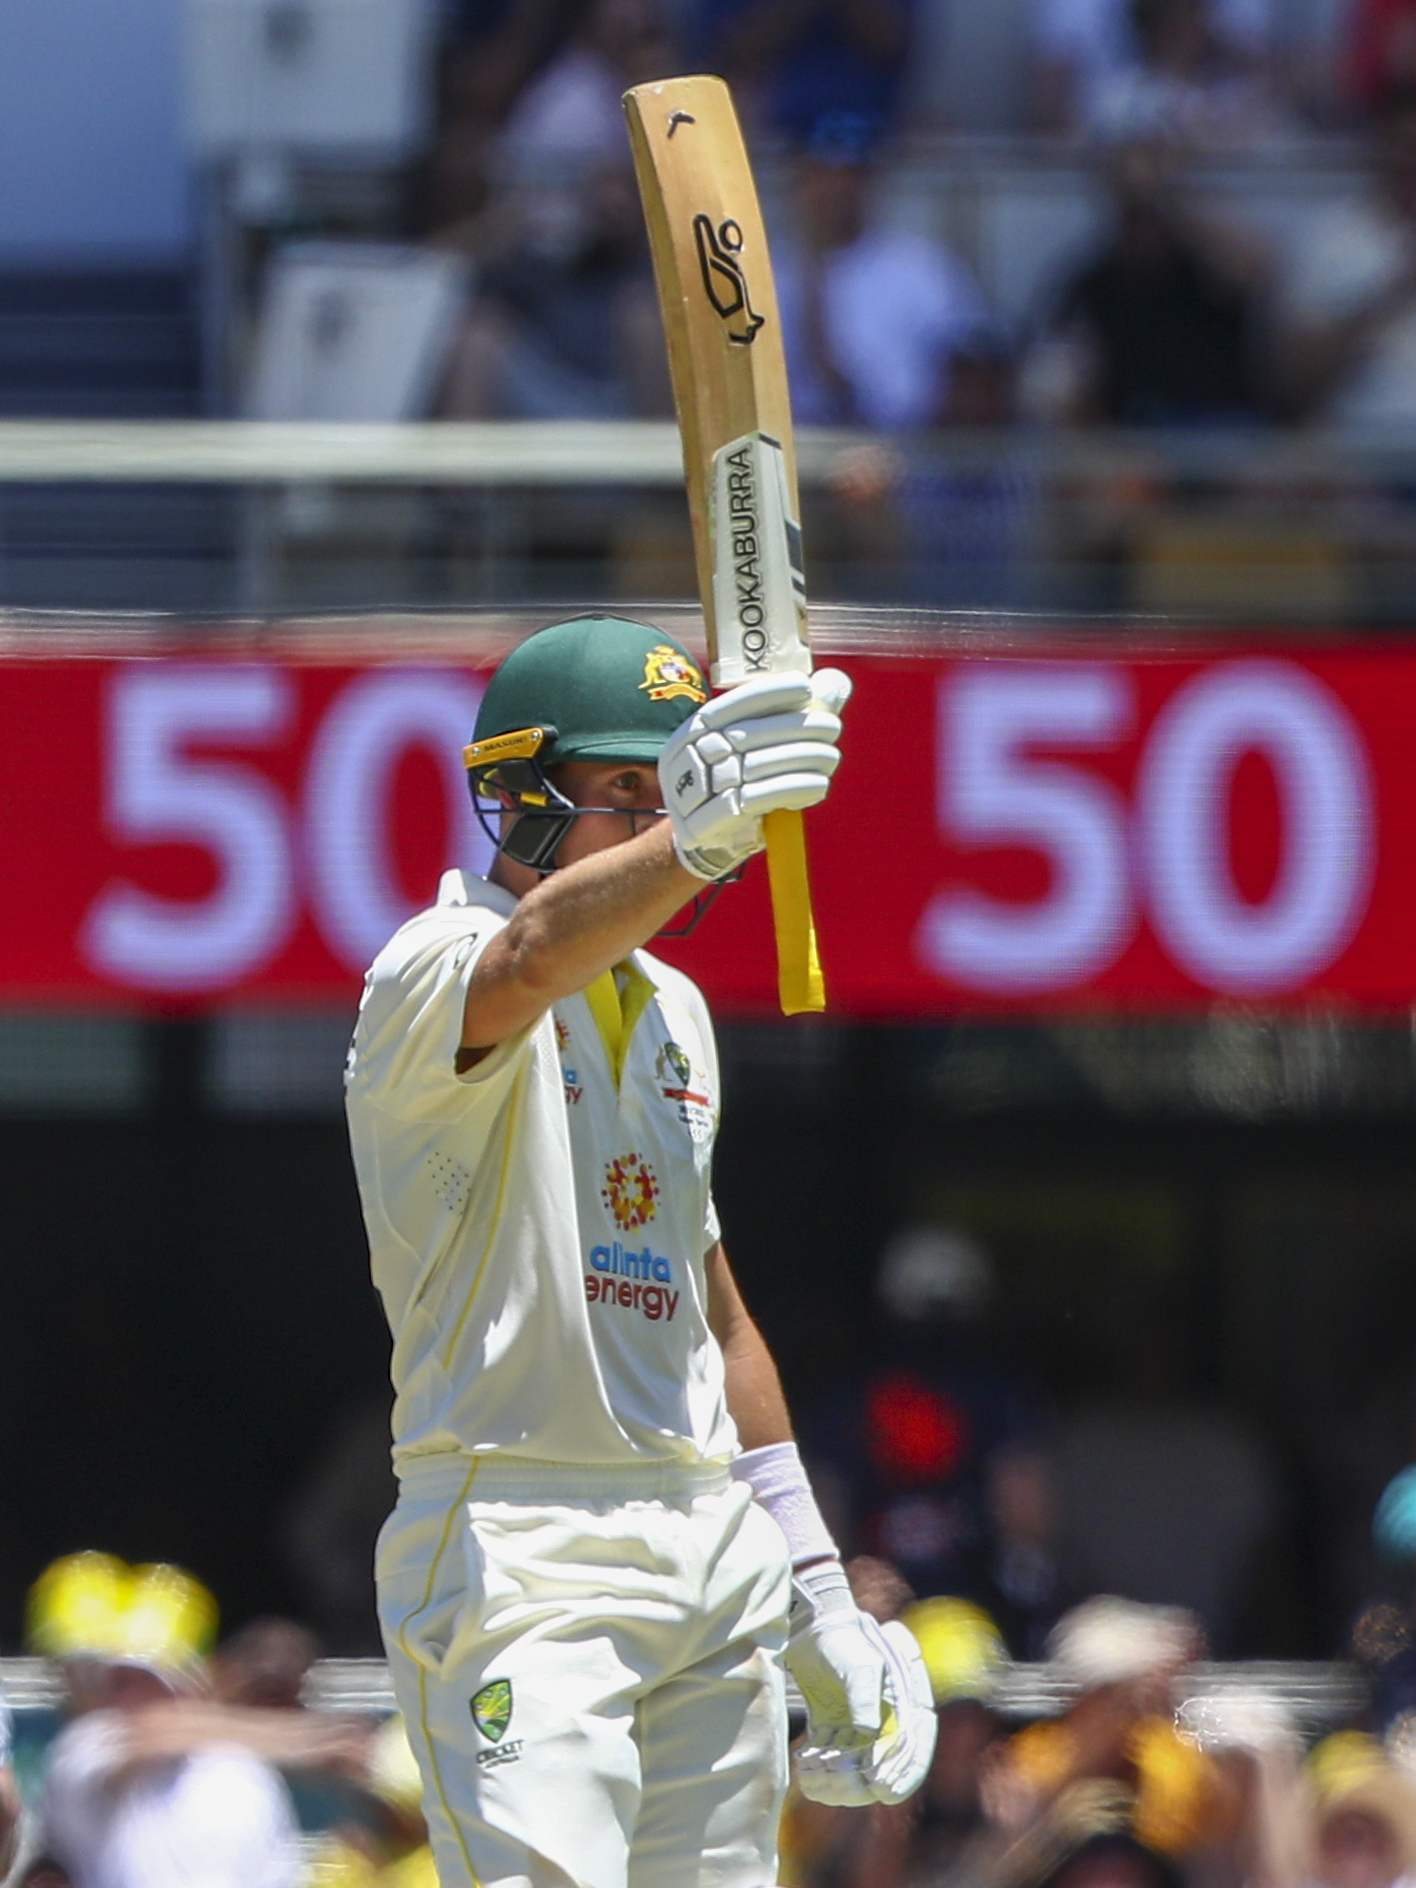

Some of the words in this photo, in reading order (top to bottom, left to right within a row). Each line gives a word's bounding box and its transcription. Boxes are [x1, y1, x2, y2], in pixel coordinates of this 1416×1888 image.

[726, 445, 770, 674] KOOKABURRA
[81, 665, 502, 991] 50
[915, 663, 1375, 996] 50
[585, 1275, 679, 1321] energy
[590, 1241, 671, 1283] alinta
